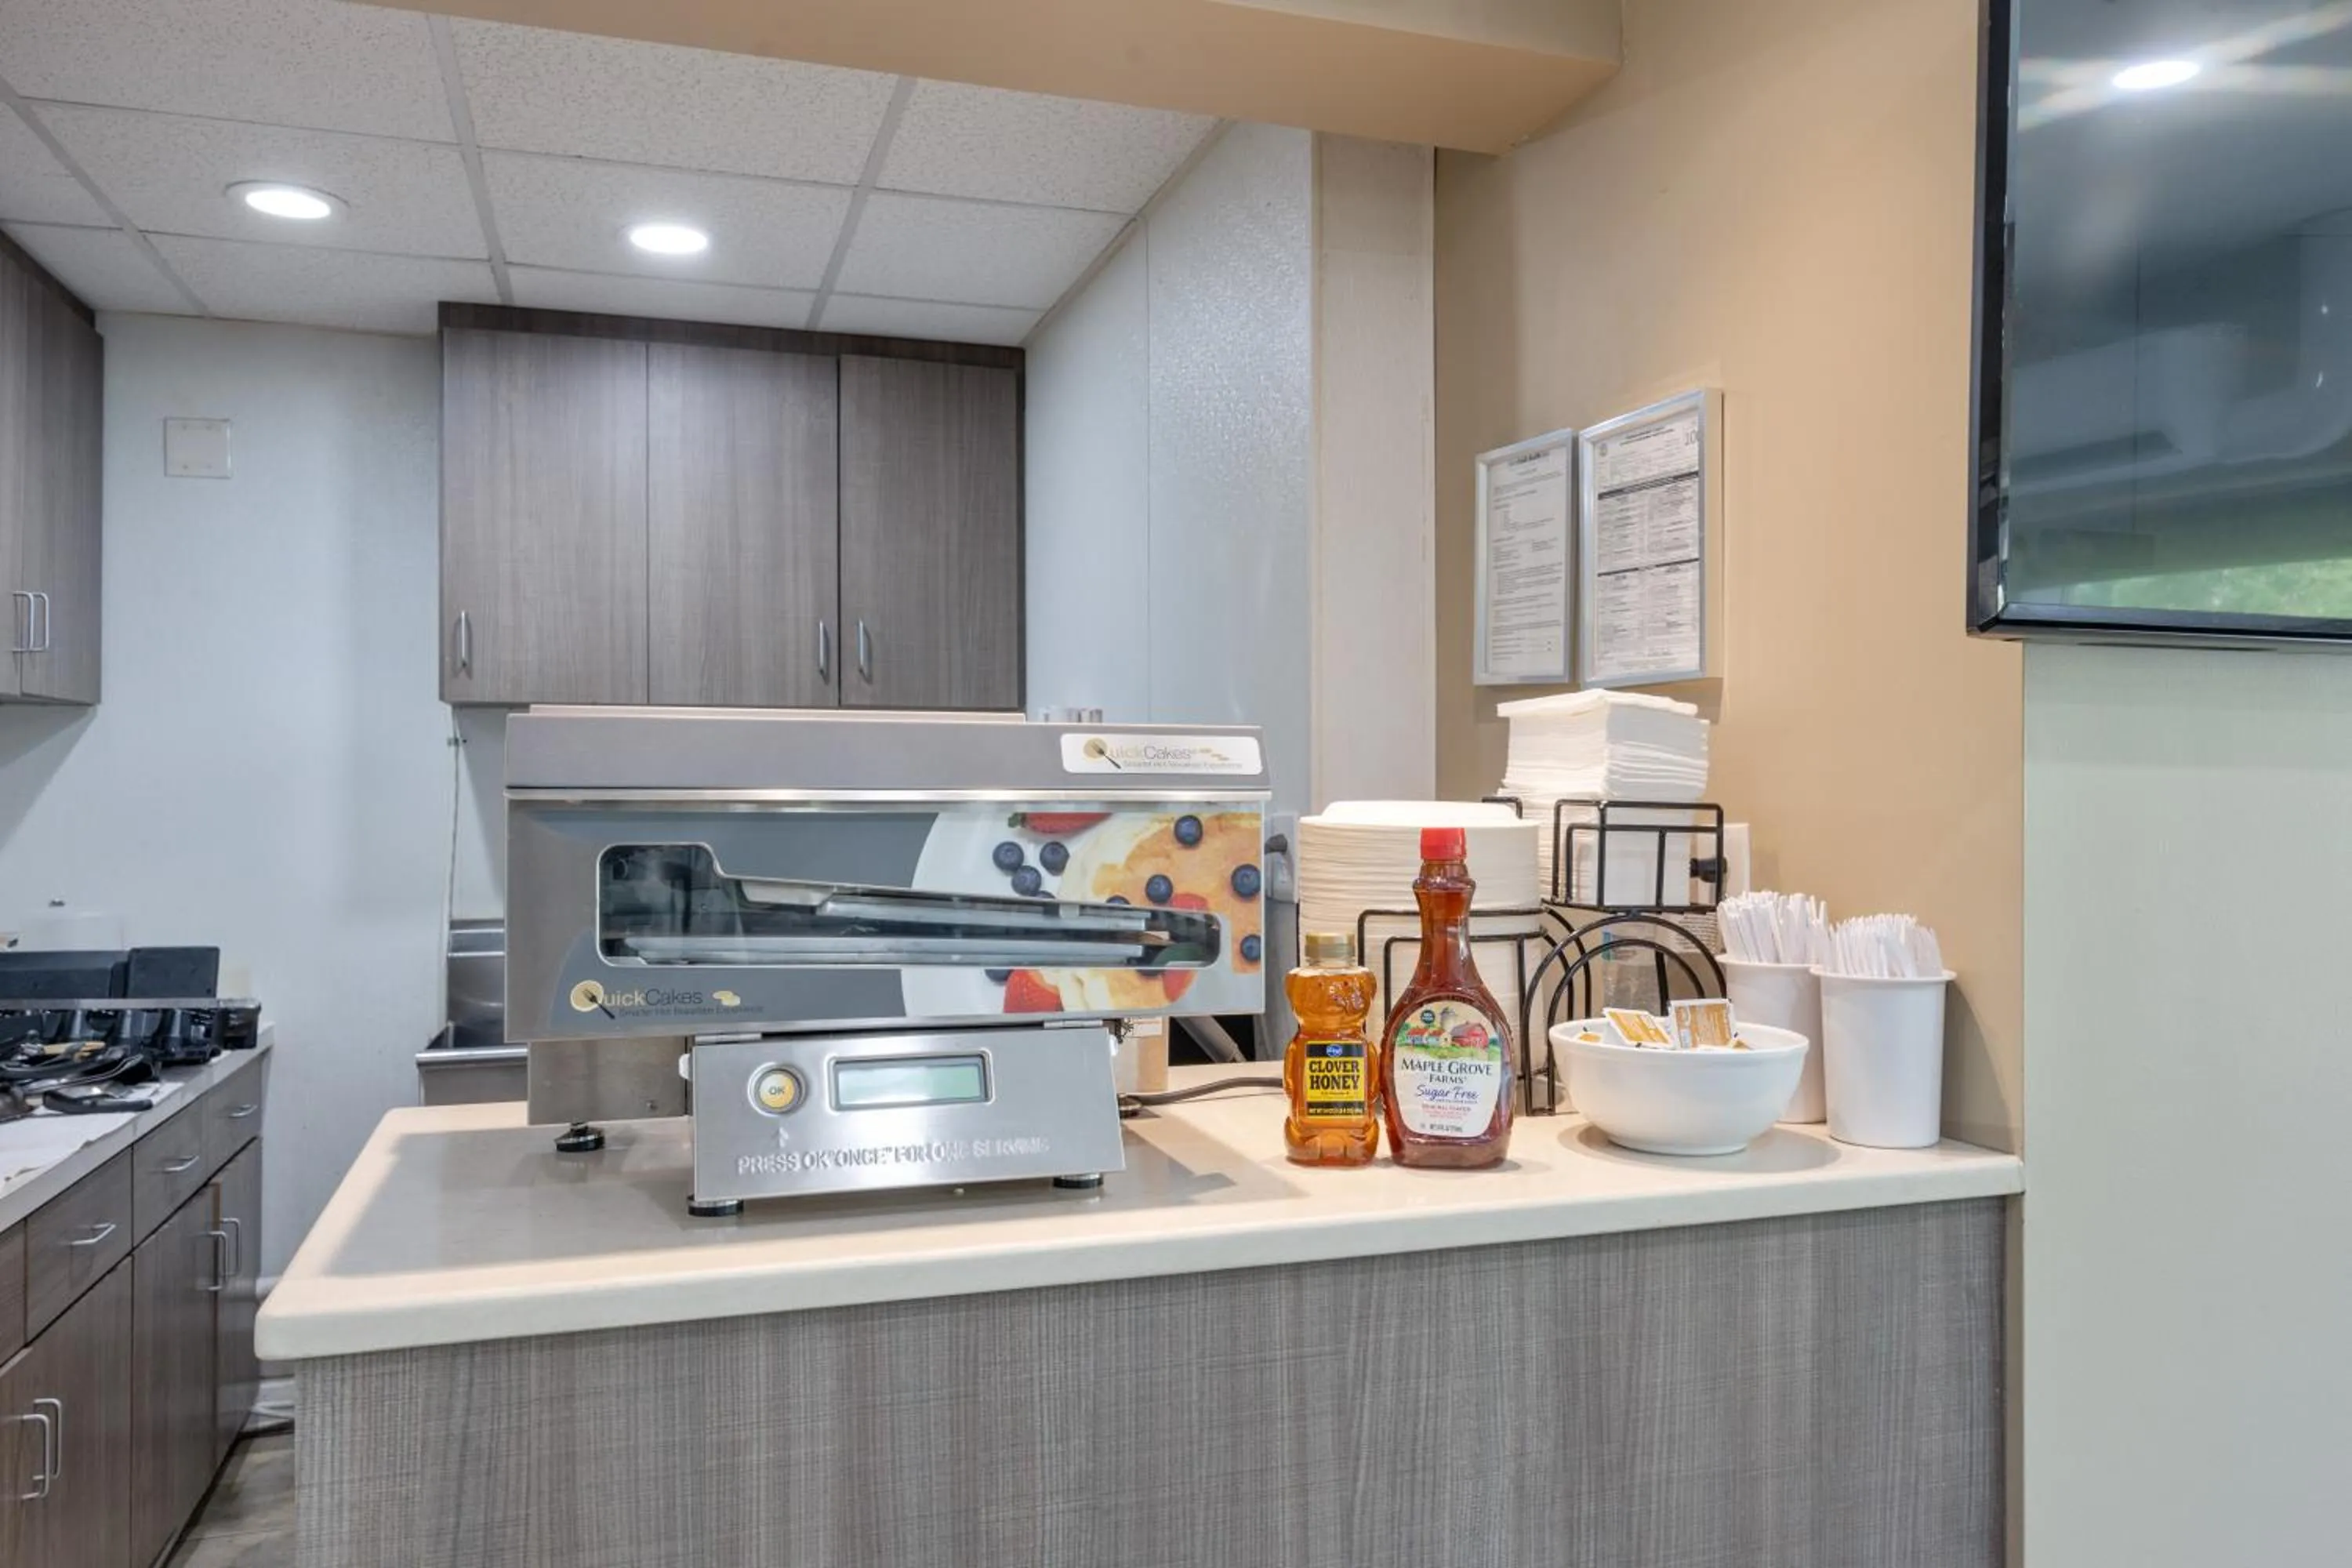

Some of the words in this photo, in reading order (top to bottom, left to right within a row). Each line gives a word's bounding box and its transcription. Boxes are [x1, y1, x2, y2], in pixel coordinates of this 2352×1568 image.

[1308, 1060, 1360, 1073] CLOVER
[1400, 1058, 1444, 1073] MAPLE
[1447, 1061, 1494, 1076] GROVE
[1309, 1074, 1360, 1091] HONEY
[1428, 1073, 1465, 1084] FARMS
[768, 1086, 785, 1095] OK
[1416, 1083, 1452, 1102] Sugar
[1453, 1086, 1480, 1099] Free
[737, 1154, 800, 1176] PRESS
[802, 1150, 829, 1171] OK
[894, 1143, 927, 1163] FOR
